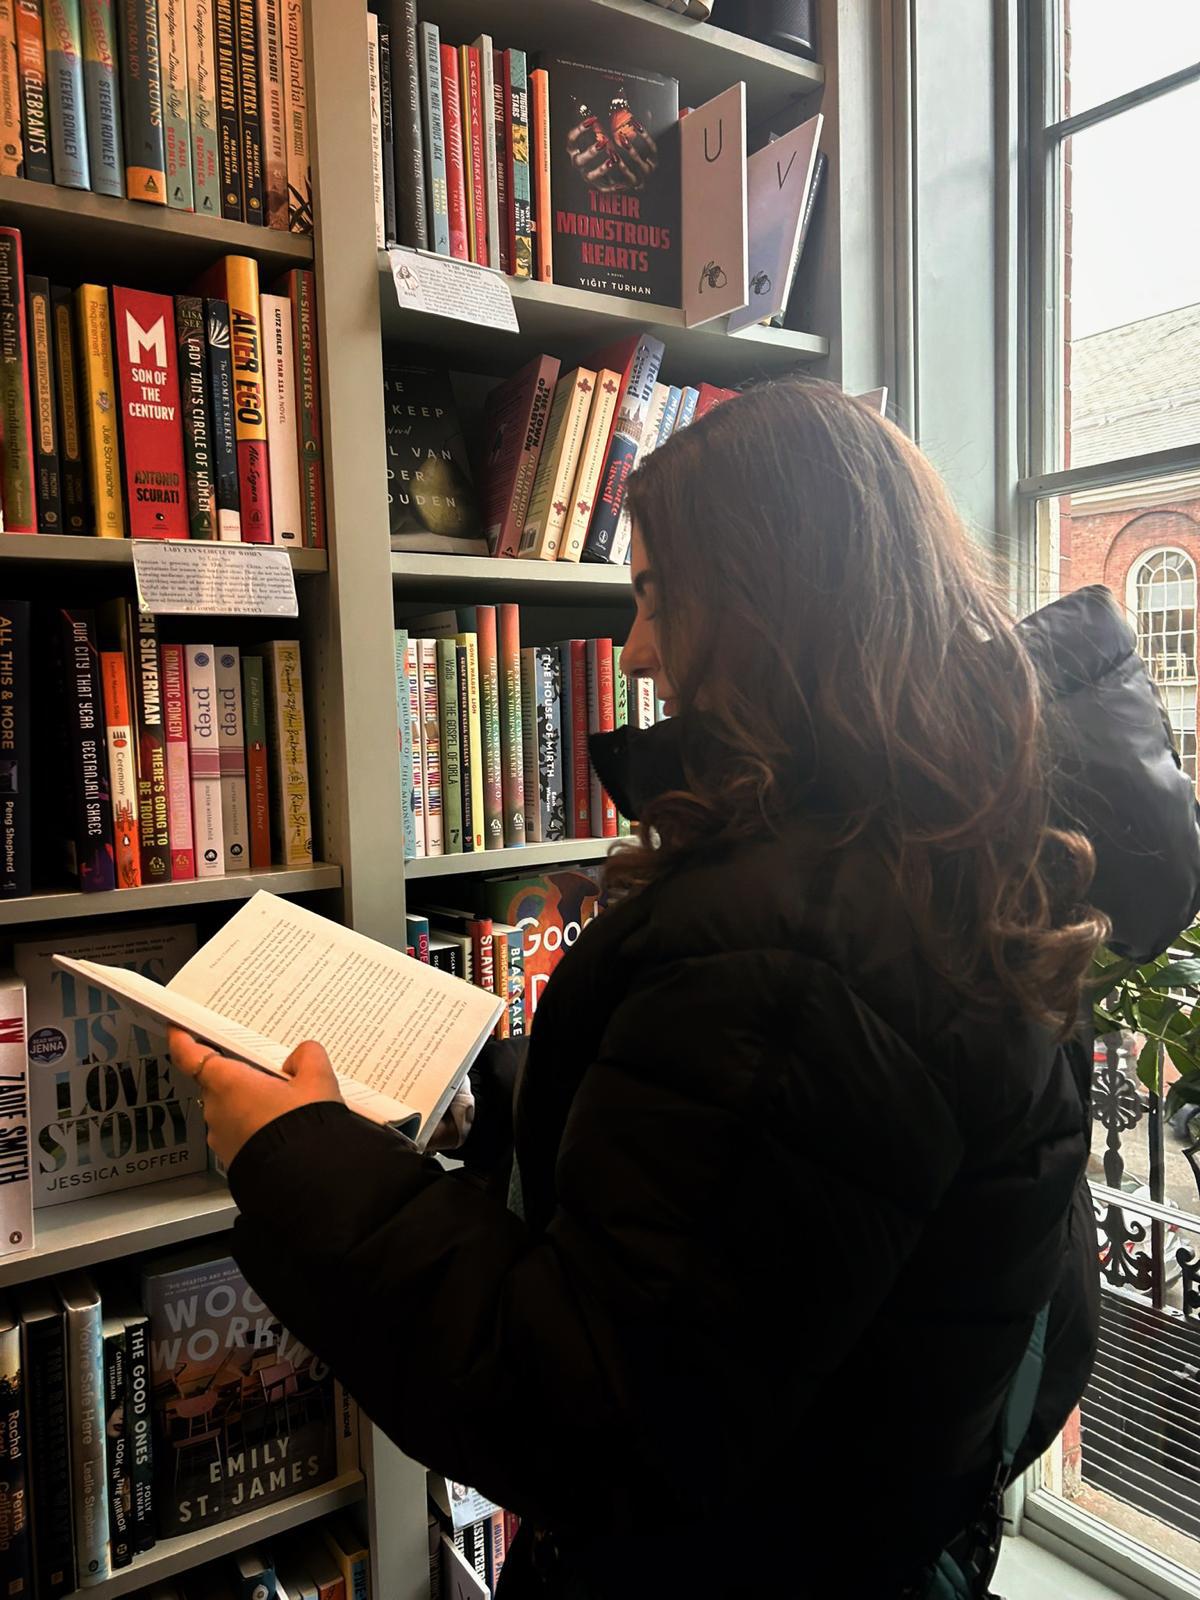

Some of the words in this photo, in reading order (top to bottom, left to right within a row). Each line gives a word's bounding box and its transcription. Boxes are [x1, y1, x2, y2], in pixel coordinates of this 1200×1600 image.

[23, 36, 40, 66] THE
[268, 39, 278, 83] RUSHDIE
[284, 2, 305, 109] Swamplandia!
[59, 69, 74, 110] STEVEN
[219, 48, 235, 112] DAUGHTERS
[470, 61, 479, 127] PAPRIKA
[24, 69, 47, 154] CELEBRANTS
[98, 80, 112, 120] STEVEN
[148, 79, 162, 127] RUINS
[270, 89, 281, 132] VICTORY
[511, 93, 520, 118] STARS
[519, 91, 528, 122] DIGGING
[62, 113, 77, 159] ROWLEY
[101, 123, 115, 169] ROWLEY
[167, 127, 176, 177] RUDNICK
[222, 125, 230, 155] CARLOS
[245, 130, 254, 160] CARLOS
[272, 135, 281, 158] CITY
[704, 119, 723, 163] U
[178, 140, 186, 169] PAUL
[196, 136, 205, 187] RUDNICK
[207, 150, 215, 177] PAUL
[224, 157, 232, 185] RUFFIN
[252, 144, 261, 178] MAURICE
[472, 135, 482, 180] YASUTAKA
[776, 151, 797, 190] V
[247, 162, 255, 189] RUFFIN
[475, 184, 483, 222] TSUTSUI
[587, 190, 641, 220] THEIR
[556, 210, 671, 251] MONSTROUS
[580, 242, 649, 272] HEARTS
[0, 242, 15, 308] Bernhard
[612, 282, 652, 296] TURHAN
[1, 311, 17, 364] Schlink
[90, 300, 100, 357] Requirement
[125, 309, 168, 368] M
[231, 308, 260, 373] ALTER
[275, 328, 283, 355] SEILER
[300, 300, 312, 349] SINGER
[187, 338, 203, 368] LADY
[131, 367, 152, 383] SON
[154, 370, 167, 386] OF
[190, 371, 205, 405] TAN'S
[277, 379, 285, 394] 111
[303, 355, 313, 409] SISTERS
[537, 377, 546, 390] OF
[627, 345, 649, 399] Crowd
[129, 402, 175, 421] CENTURY
[141, 386, 161, 403] THE
[236, 379, 263, 426] EGO
[541, 386, 551, 410] THE
[102, 425, 112, 445] Julie
[192, 407, 207, 448] CIRCLE
[524, 390, 542, 454] BABYLON
[532, 410, 549, 448] TOWN
[195, 452, 209, 467] OF
[411, 447, 453, 460] VAN
[104, 446, 116, 499] Schumacher
[134, 470, 179, 487] ANTONIO
[308, 466, 316, 498] SARAH
[387, 469, 424, 481] DER
[136, 487, 180, 504] SCURATI
[196, 471, 211, 512] WOMEN
[310, 501, 318, 538] SELTZER
[0, 616, 13, 646] ALL
[73, 622, 88, 643] OUR
[1, 651, 14, 688] THIS
[75, 646, 90, 669] CITY
[164, 649, 181, 698] ROMANTIC
[445, 659, 455, 681] Walls
[541, 655, 552, 678] THE
[600, 657, 612, 687] WEIKE
[2, 690, 14, 700] &
[77, 673, 92, 698] THAT
[140, 638, 161, 725] SILVERMAN
[483, 674, 492, 701] KAREN
[507, 670, 515, 697] KAREN
[78, 702, 95, 729] YEAR
[192, 687, 212, 738] prep
[219, 687, 238, 737] prep
[446, 701, 456, 717] THE
[543, 681, 553, 719] HOUSE
[602, 693, 612, 721] WANG
[1, 705, 15, 750] MORE
[167, 699, 183, 739] COMEDY
[446, 719, 458, 749] GOSPEL
[484, 702, 493, 749] THOMPSON
[508, 699, 517, 744] THOMPSON
[545, 722, 554, 739] OF
[81, 740, 99, 799] GEETANJALI
[152, 747, 165, 792] THERE'S
[426, 738, 440, 772] ADELLE
[447, 751, 459, 763] OF
[486, 750, 495, 784] WALKER
[509, 746, 518, 778] WALKER
[545, 742, 555, 777] MIRTH
[116, 752, 126, 796] Ceremony
[139, 781, 152, 796] BE
[254, 765, 264, 790] Watch
[448, 764, 459, 785] ORLA
[255, 792, 264, 803] Us
[428, 772, 441, 817] WALDMAN
[4, 801, 14, 825] Peng
[87, 803, 102, 836] SHREE
[141, 798, 155, 848] TROUBLE
[154, 796, 167, 829] GOING
[256, 804, 265, 830] Dance
[5, 827, 16, 873] Shepherd
[157, 831, 168, 846] TO
[510, 947, 524, 994] BLACK
[512, 996, 523, 1036] CAKE
[30, 1040, 65, 1056] JENNA
[48, 1035, 62, 1043] WITH
[55, 1053, 177, 1121] LOVE
[38, 1096, 194, 1175] STORY
[46, 1165, 120, 1192] JESSICA
[125, 1150, 190, 1174] SOFFER
[79, 1321, 95, 1369] You're
[131, 1328, 145, 1359] THE
[150, 1316, 330, 1383] WORKING
[80, 1372, 95, 1407] Safe
[132, 1364, 147, 1415] GOOD
[7, 1409, 22, 1460] Rachel
[81, 1408, 95, 1445] Here
[134, 1419, 148, 1465] ONES
[113, 1438, 125, 1466] LOOK
[209, 1436, 290, 1484] EMILY
[112, 1467, 121, 1479] IN
[114, 1478, 125, 1496] THE
[178, 1494, 220, 1523] ST.
[231, 1454, 321, 1506] JAMES
[12, 1489, 25, 1536] Perris,
[112, 1496, 127, 1532] MIRROR
[136, 1481, 145, 1522] STEWART
[144, 1484, 152, 1511] POLLY
